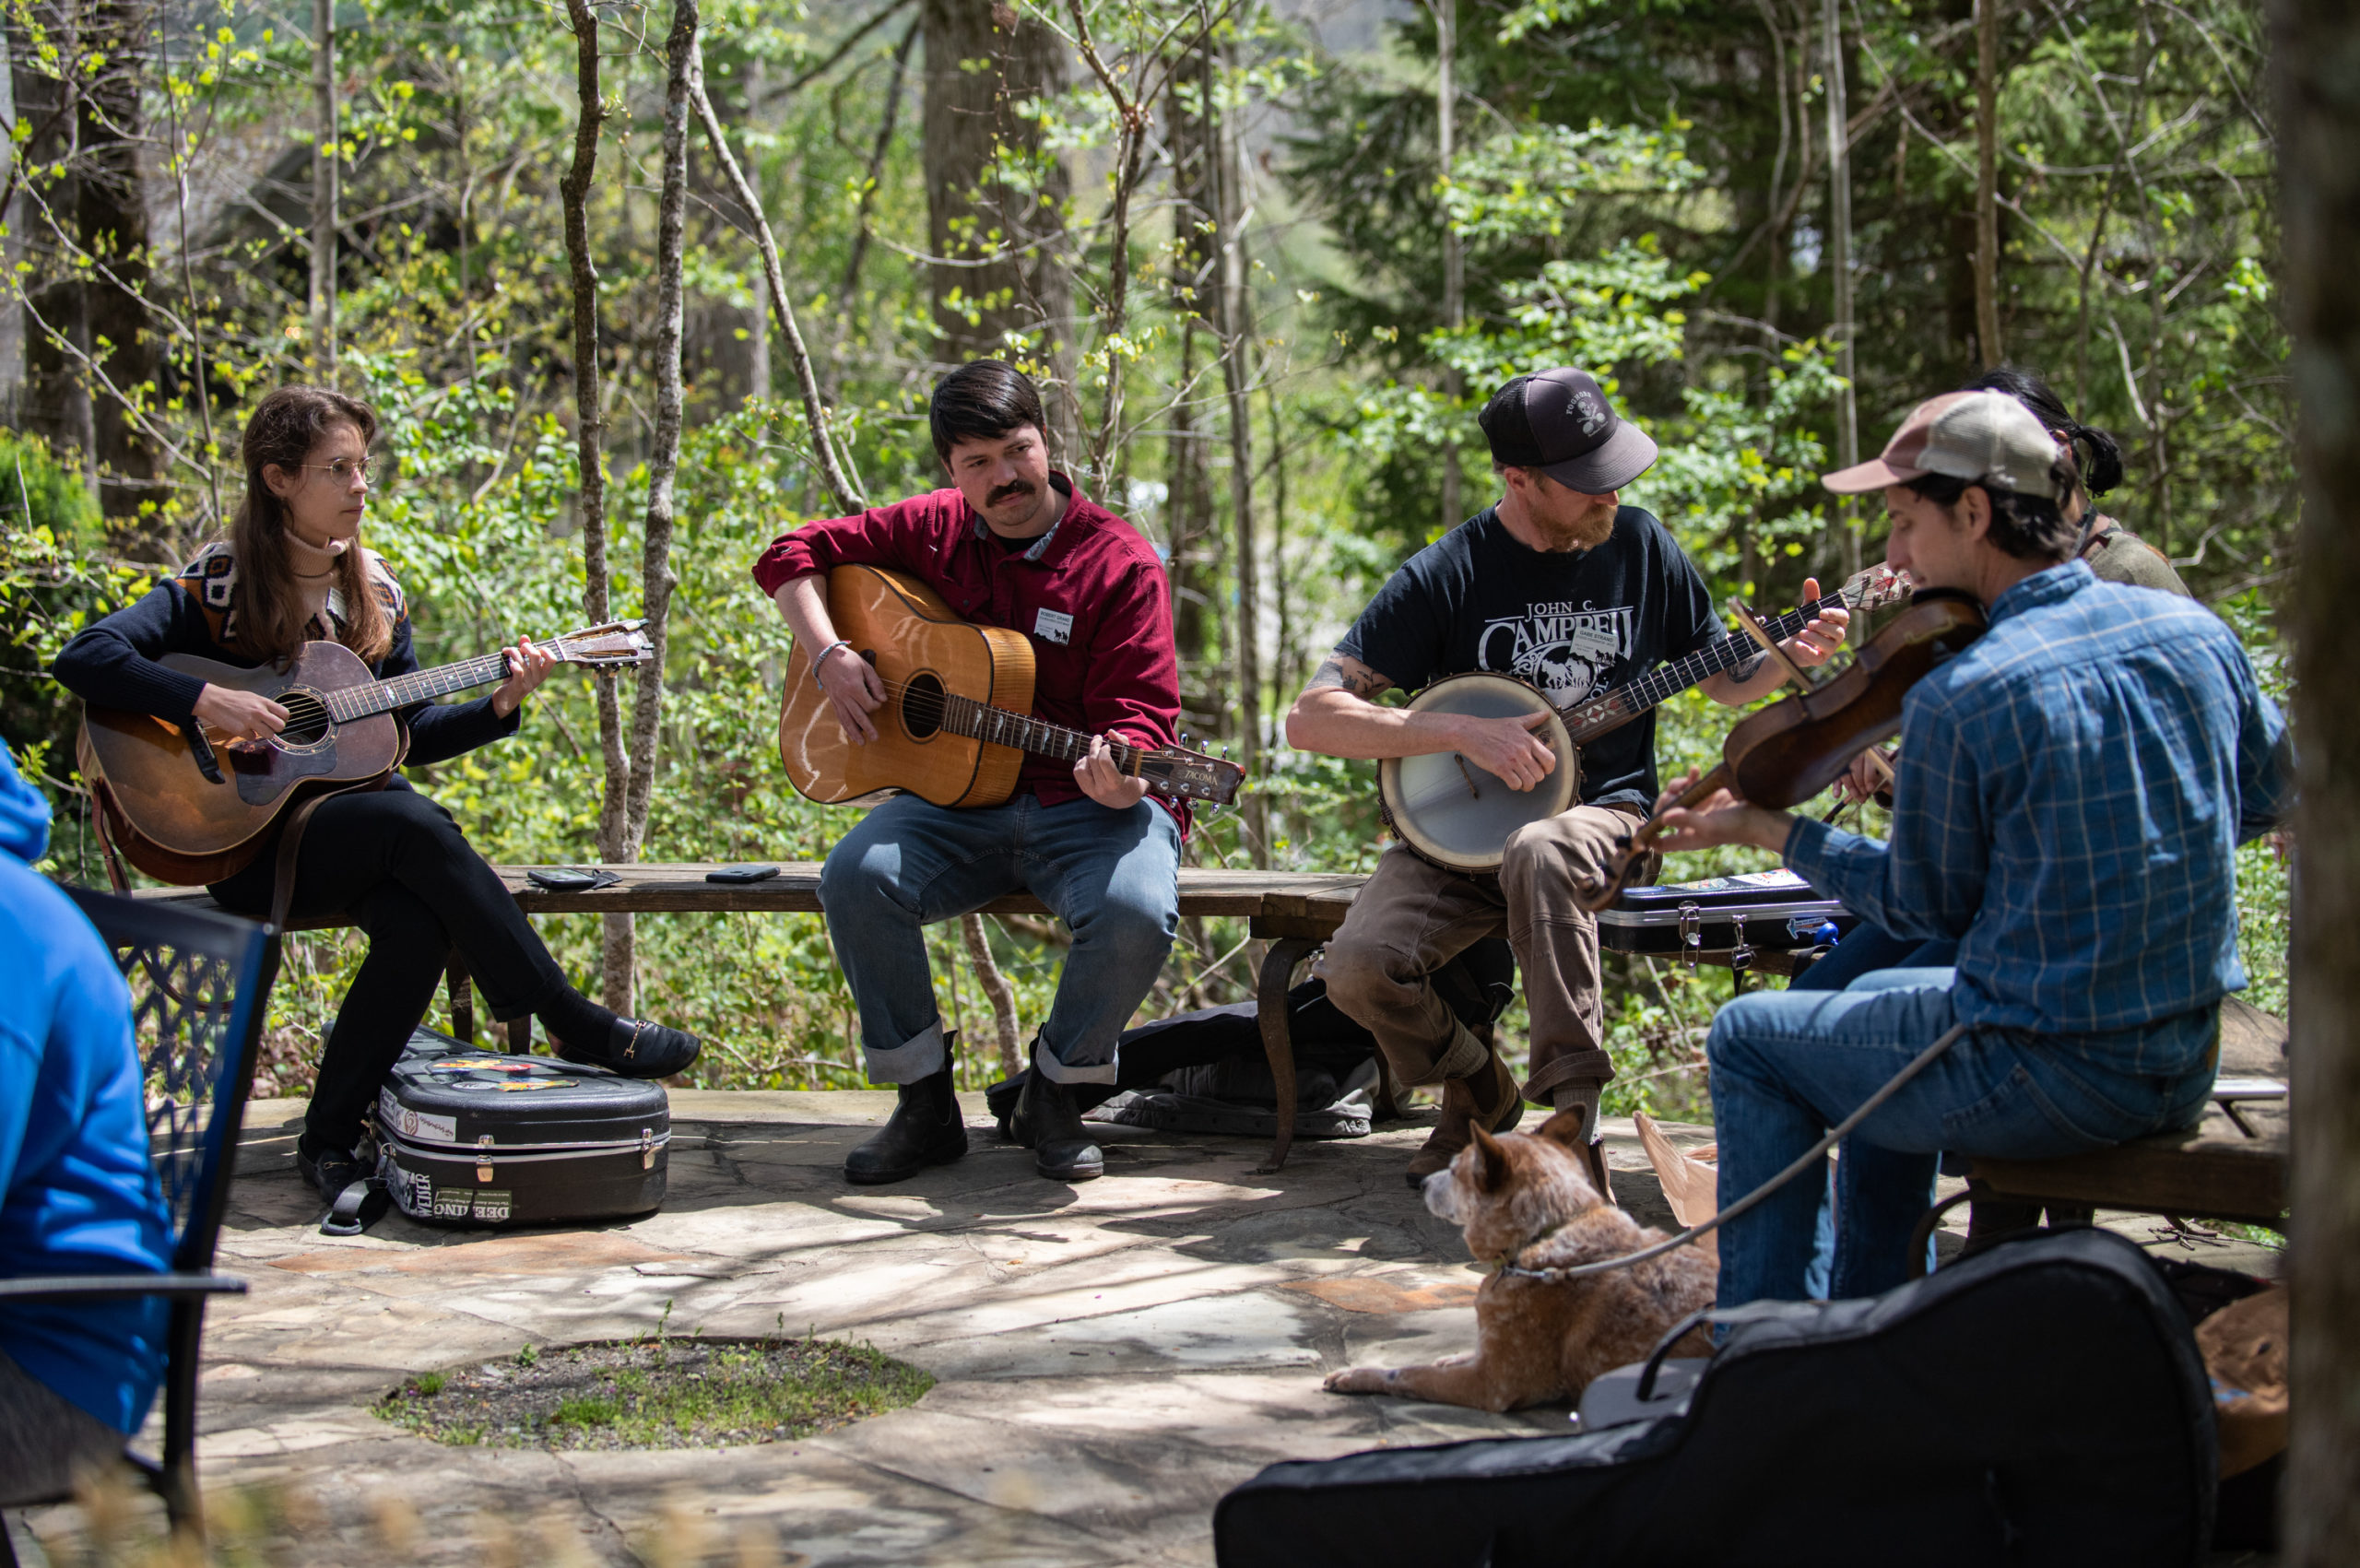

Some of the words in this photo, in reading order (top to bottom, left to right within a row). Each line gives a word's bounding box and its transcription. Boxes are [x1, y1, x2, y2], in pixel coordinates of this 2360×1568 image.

[1525, 601, 1573, 622] JOHN
[1582, 599, 1597, 611] C.
[1185, 770, 1218, 785] TACOMA
[416, 1173, 432, 1217] WEISER
